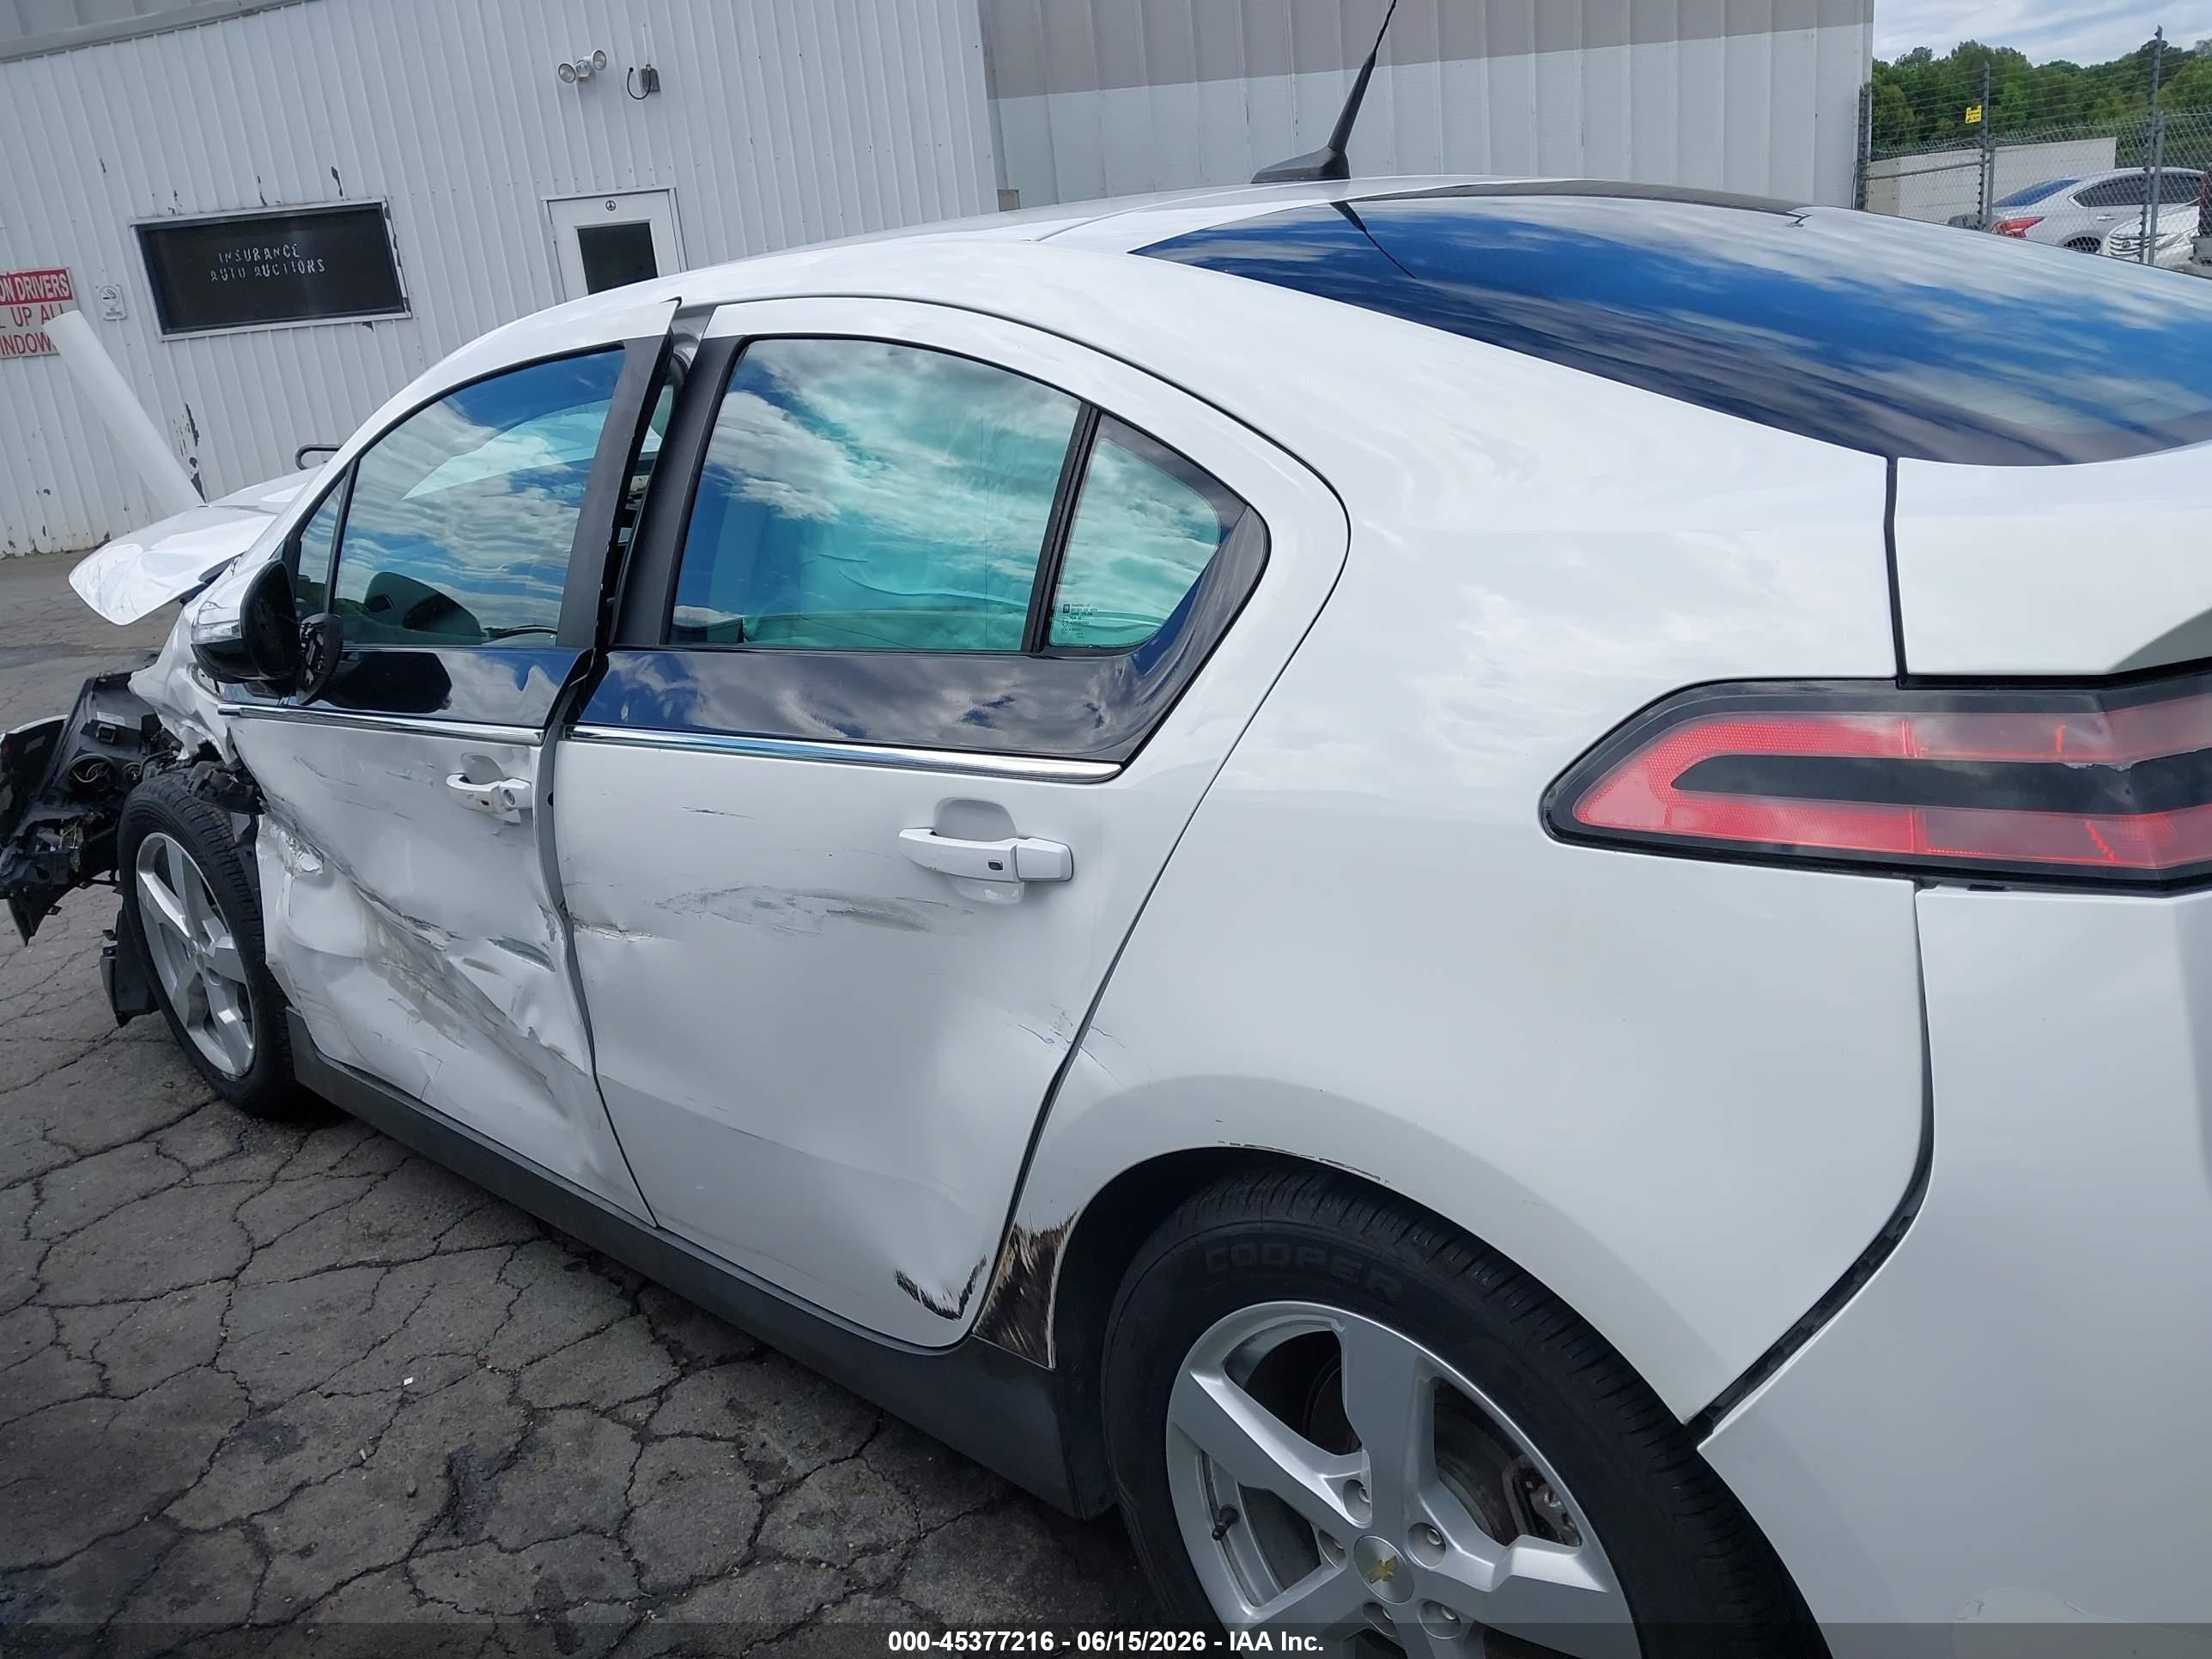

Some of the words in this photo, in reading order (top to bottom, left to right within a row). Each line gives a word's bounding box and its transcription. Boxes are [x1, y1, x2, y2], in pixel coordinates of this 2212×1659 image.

[218, 243, 300, 264] INSURANCE
[210, 267, 246, 282] AUTO
[254, 258, 325, 277] AUCTIONS
[15, 273, 70, 301] DRIVERS
[10, 307, 32, 327] UP
[0, 331, 58, 356] INDOW
[1205, 1243, 1404, 1300] COOPER
